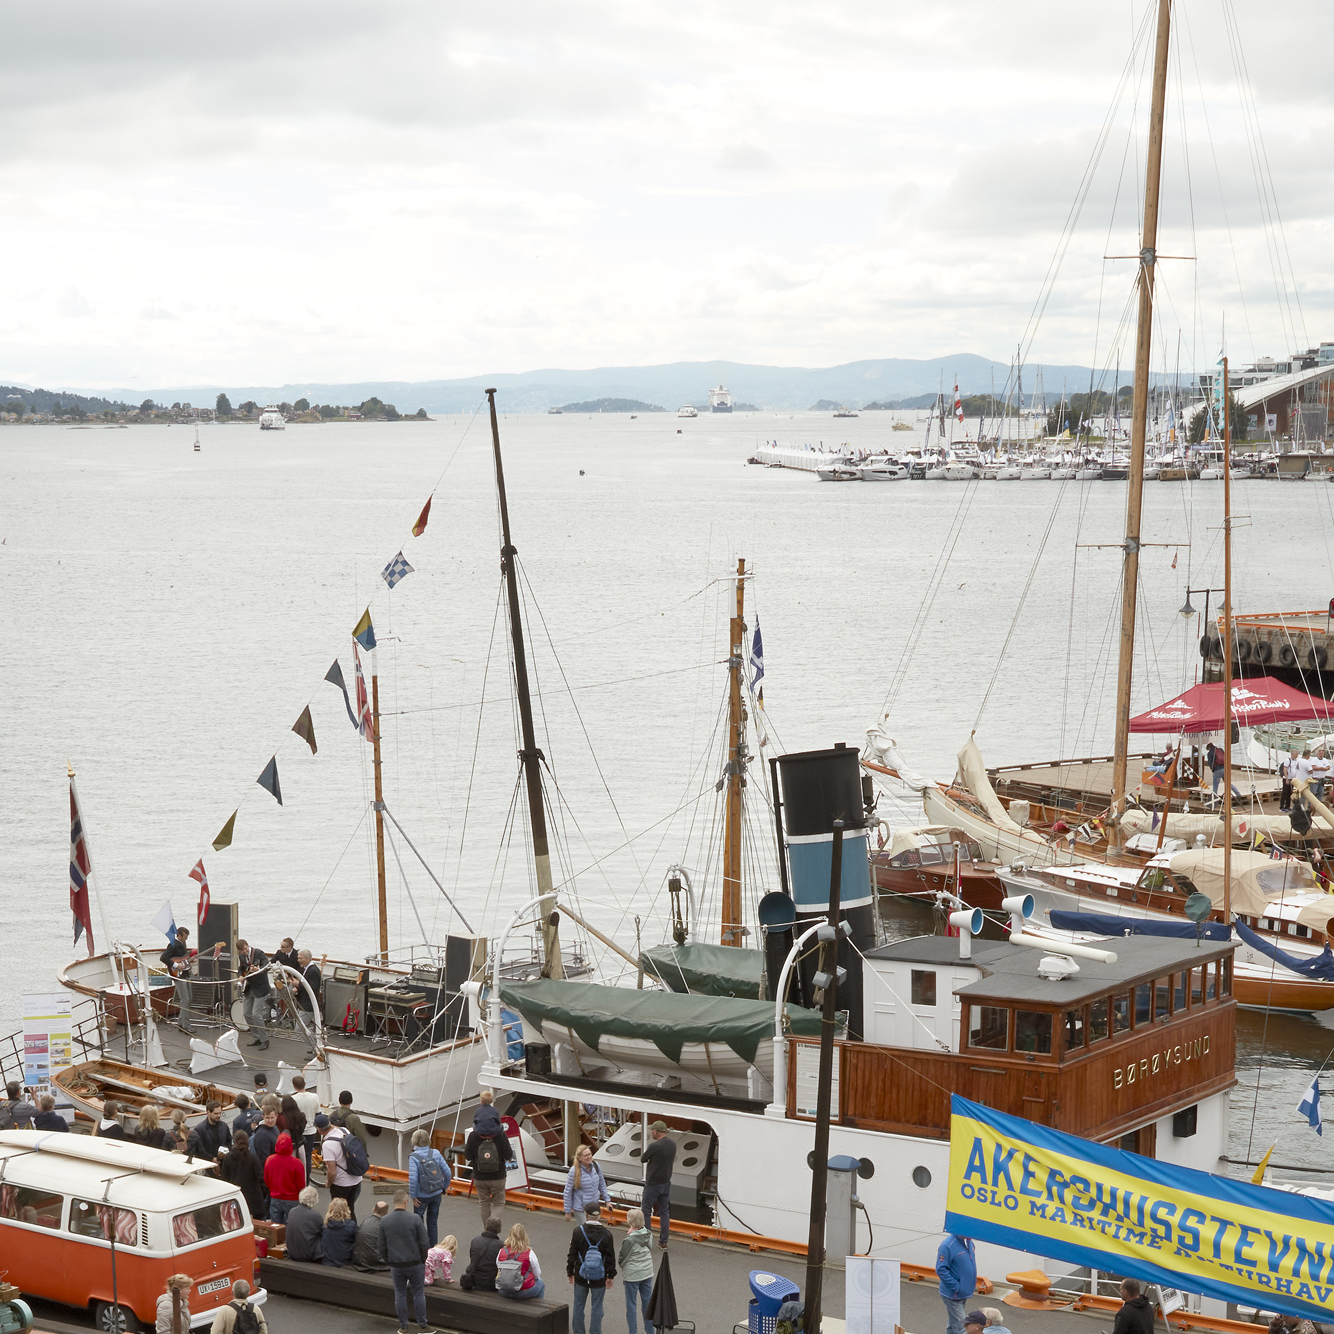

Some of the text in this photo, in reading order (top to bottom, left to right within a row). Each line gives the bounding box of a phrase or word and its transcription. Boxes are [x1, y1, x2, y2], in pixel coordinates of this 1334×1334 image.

[1113, 1035, 1210, 1090] BØRØYSUND
[960, 1182, 1019, 1211] OSLO
[1028, 1199, 1163, 1251] MARITIME
